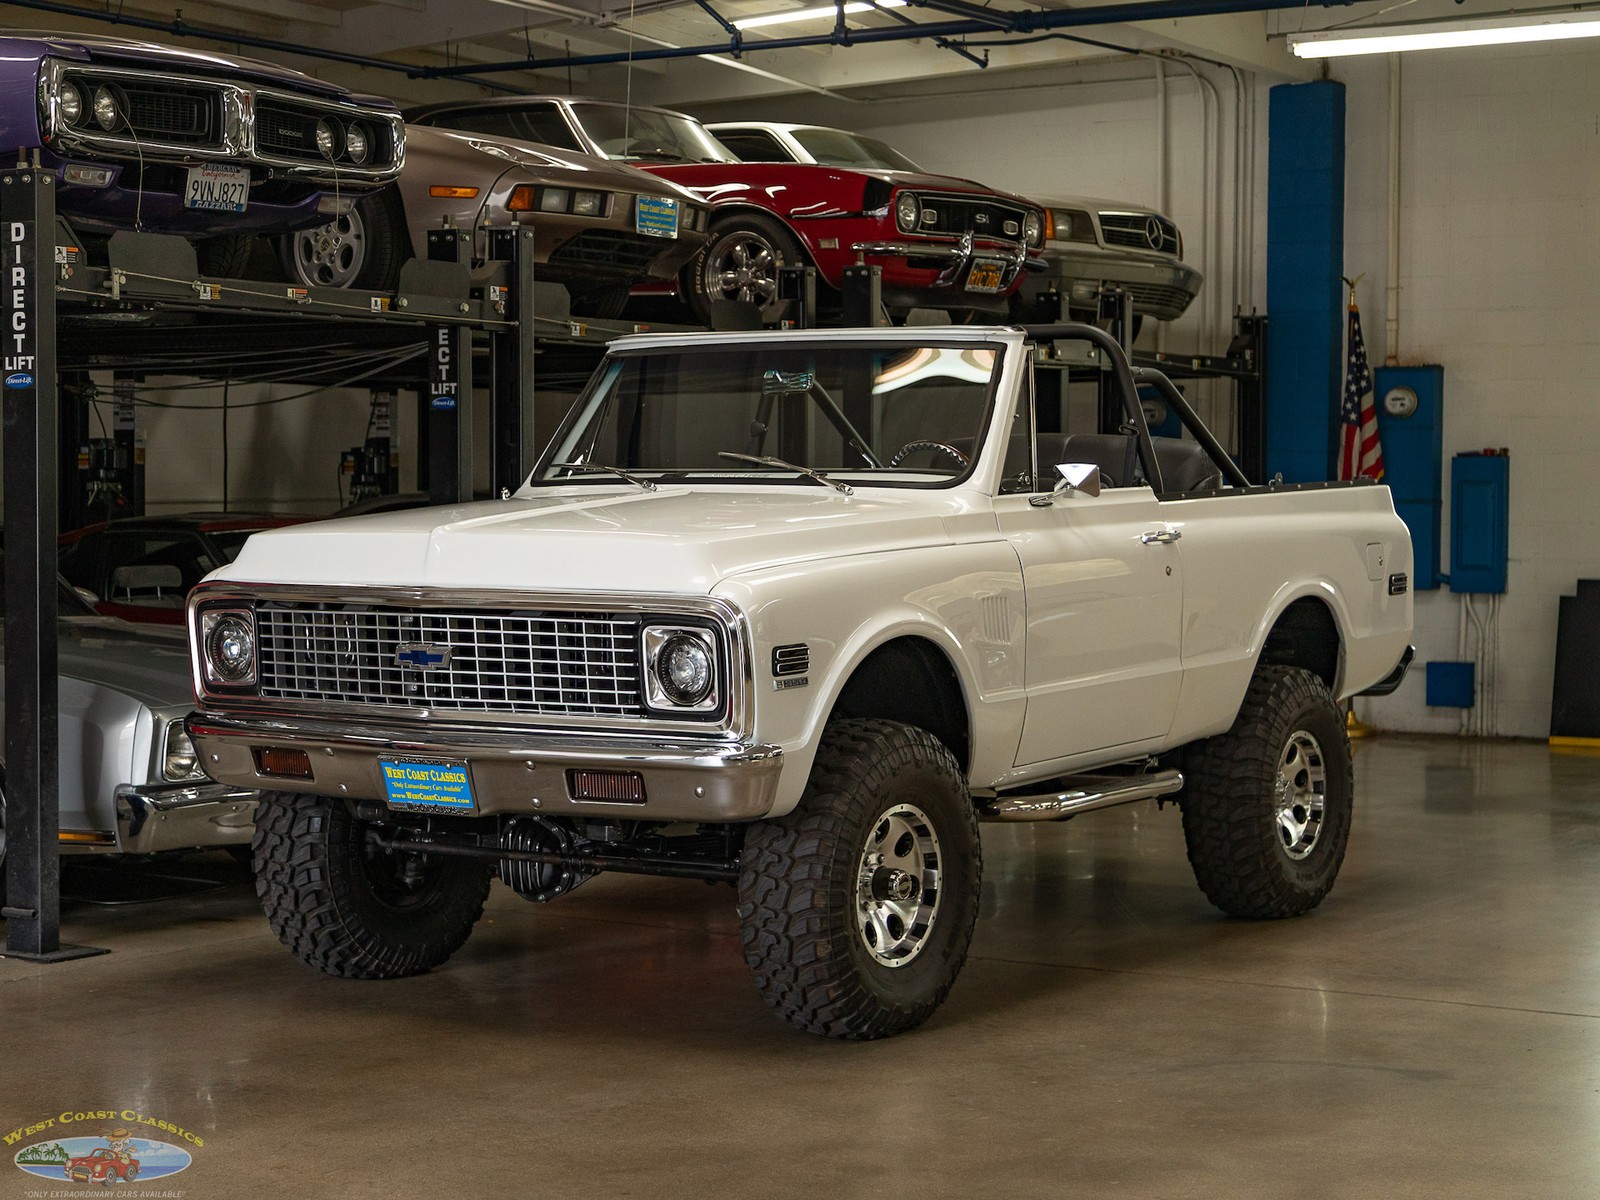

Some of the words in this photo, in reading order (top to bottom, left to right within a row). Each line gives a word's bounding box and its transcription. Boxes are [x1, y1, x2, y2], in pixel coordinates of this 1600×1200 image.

[190, 180, 245, 203] 9VNJ827
[11, 222, 26, 353] DIRECT
[5, 356, 35, 371] LIFT
[438, 328, 450, 380] ECT
[431, 382, 457, 395] LIFT
[385, 766, 405, 779] WEST
[406, 768, 430, 781] COAST
[430, 769, 467, 784] CLASSICS
